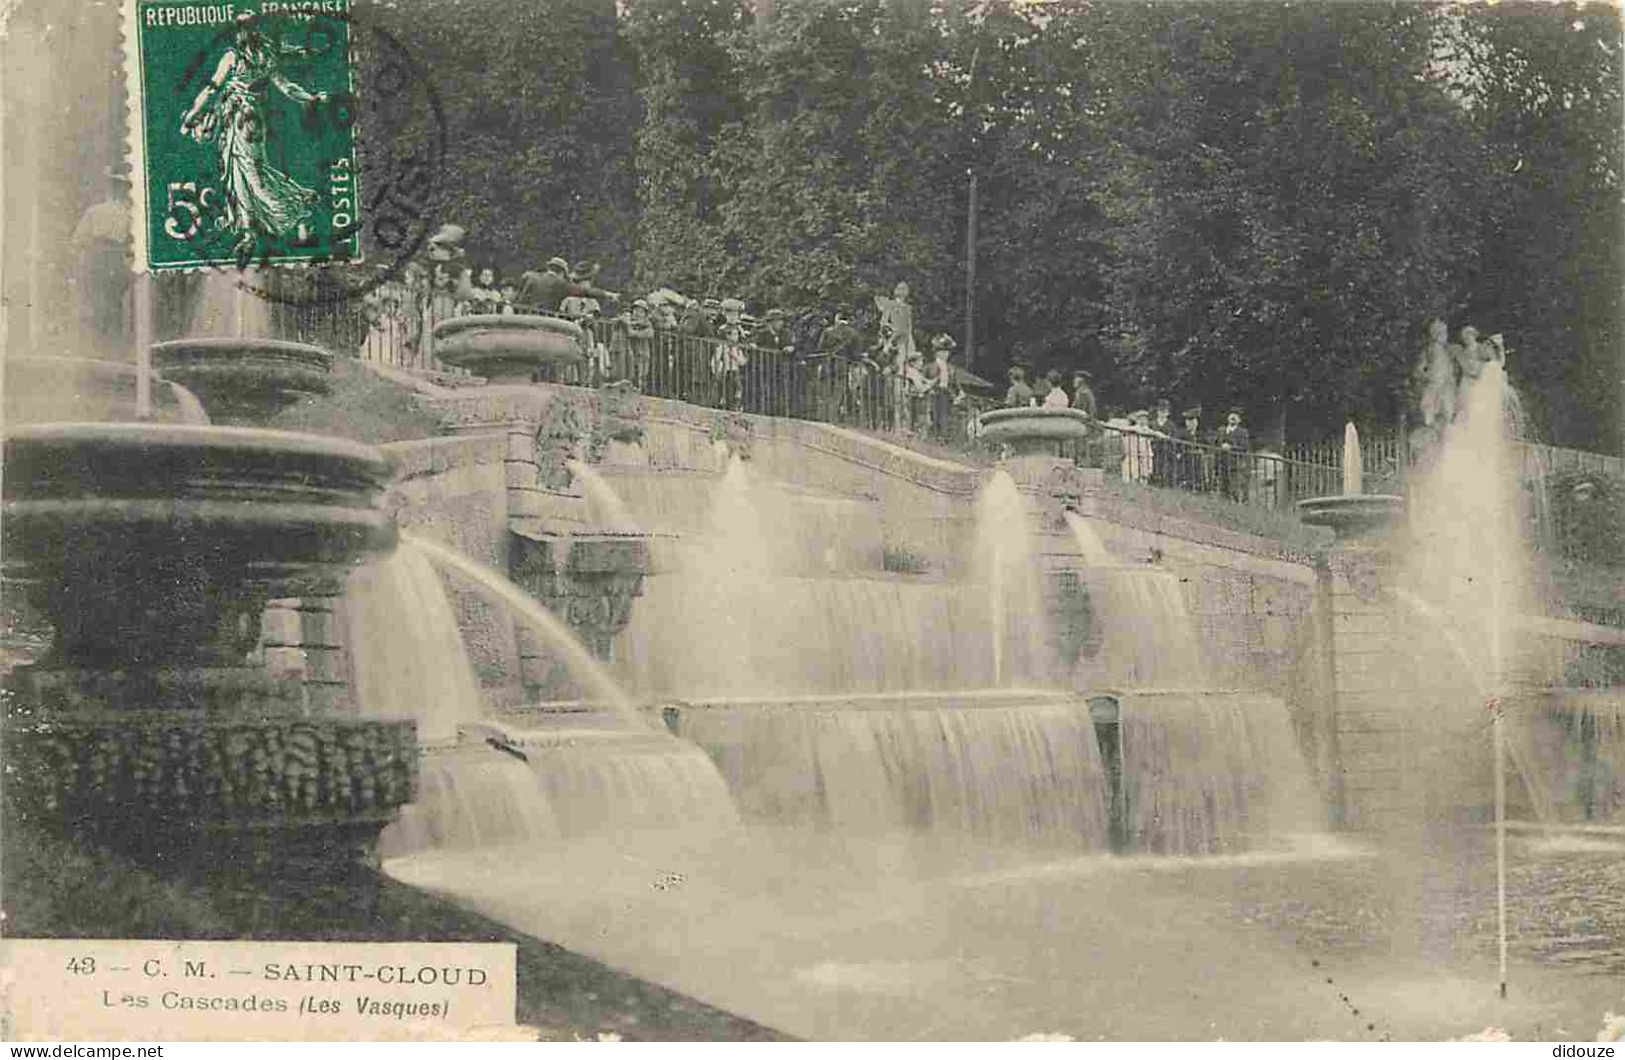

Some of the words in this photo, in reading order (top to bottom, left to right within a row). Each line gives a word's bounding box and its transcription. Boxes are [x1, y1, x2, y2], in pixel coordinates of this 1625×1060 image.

[331, 158, 351, 250] OSTES
[143, 959, 168, 978] C.
[185, 961, 216, 979] M.
[264, 963, 487, 986] SAINT-CLOUD
[161, 991, 288, 1013] Cascades
[300, 996, 341, 1016] (Les
[356, 998, 449, 1020] Vasques)
